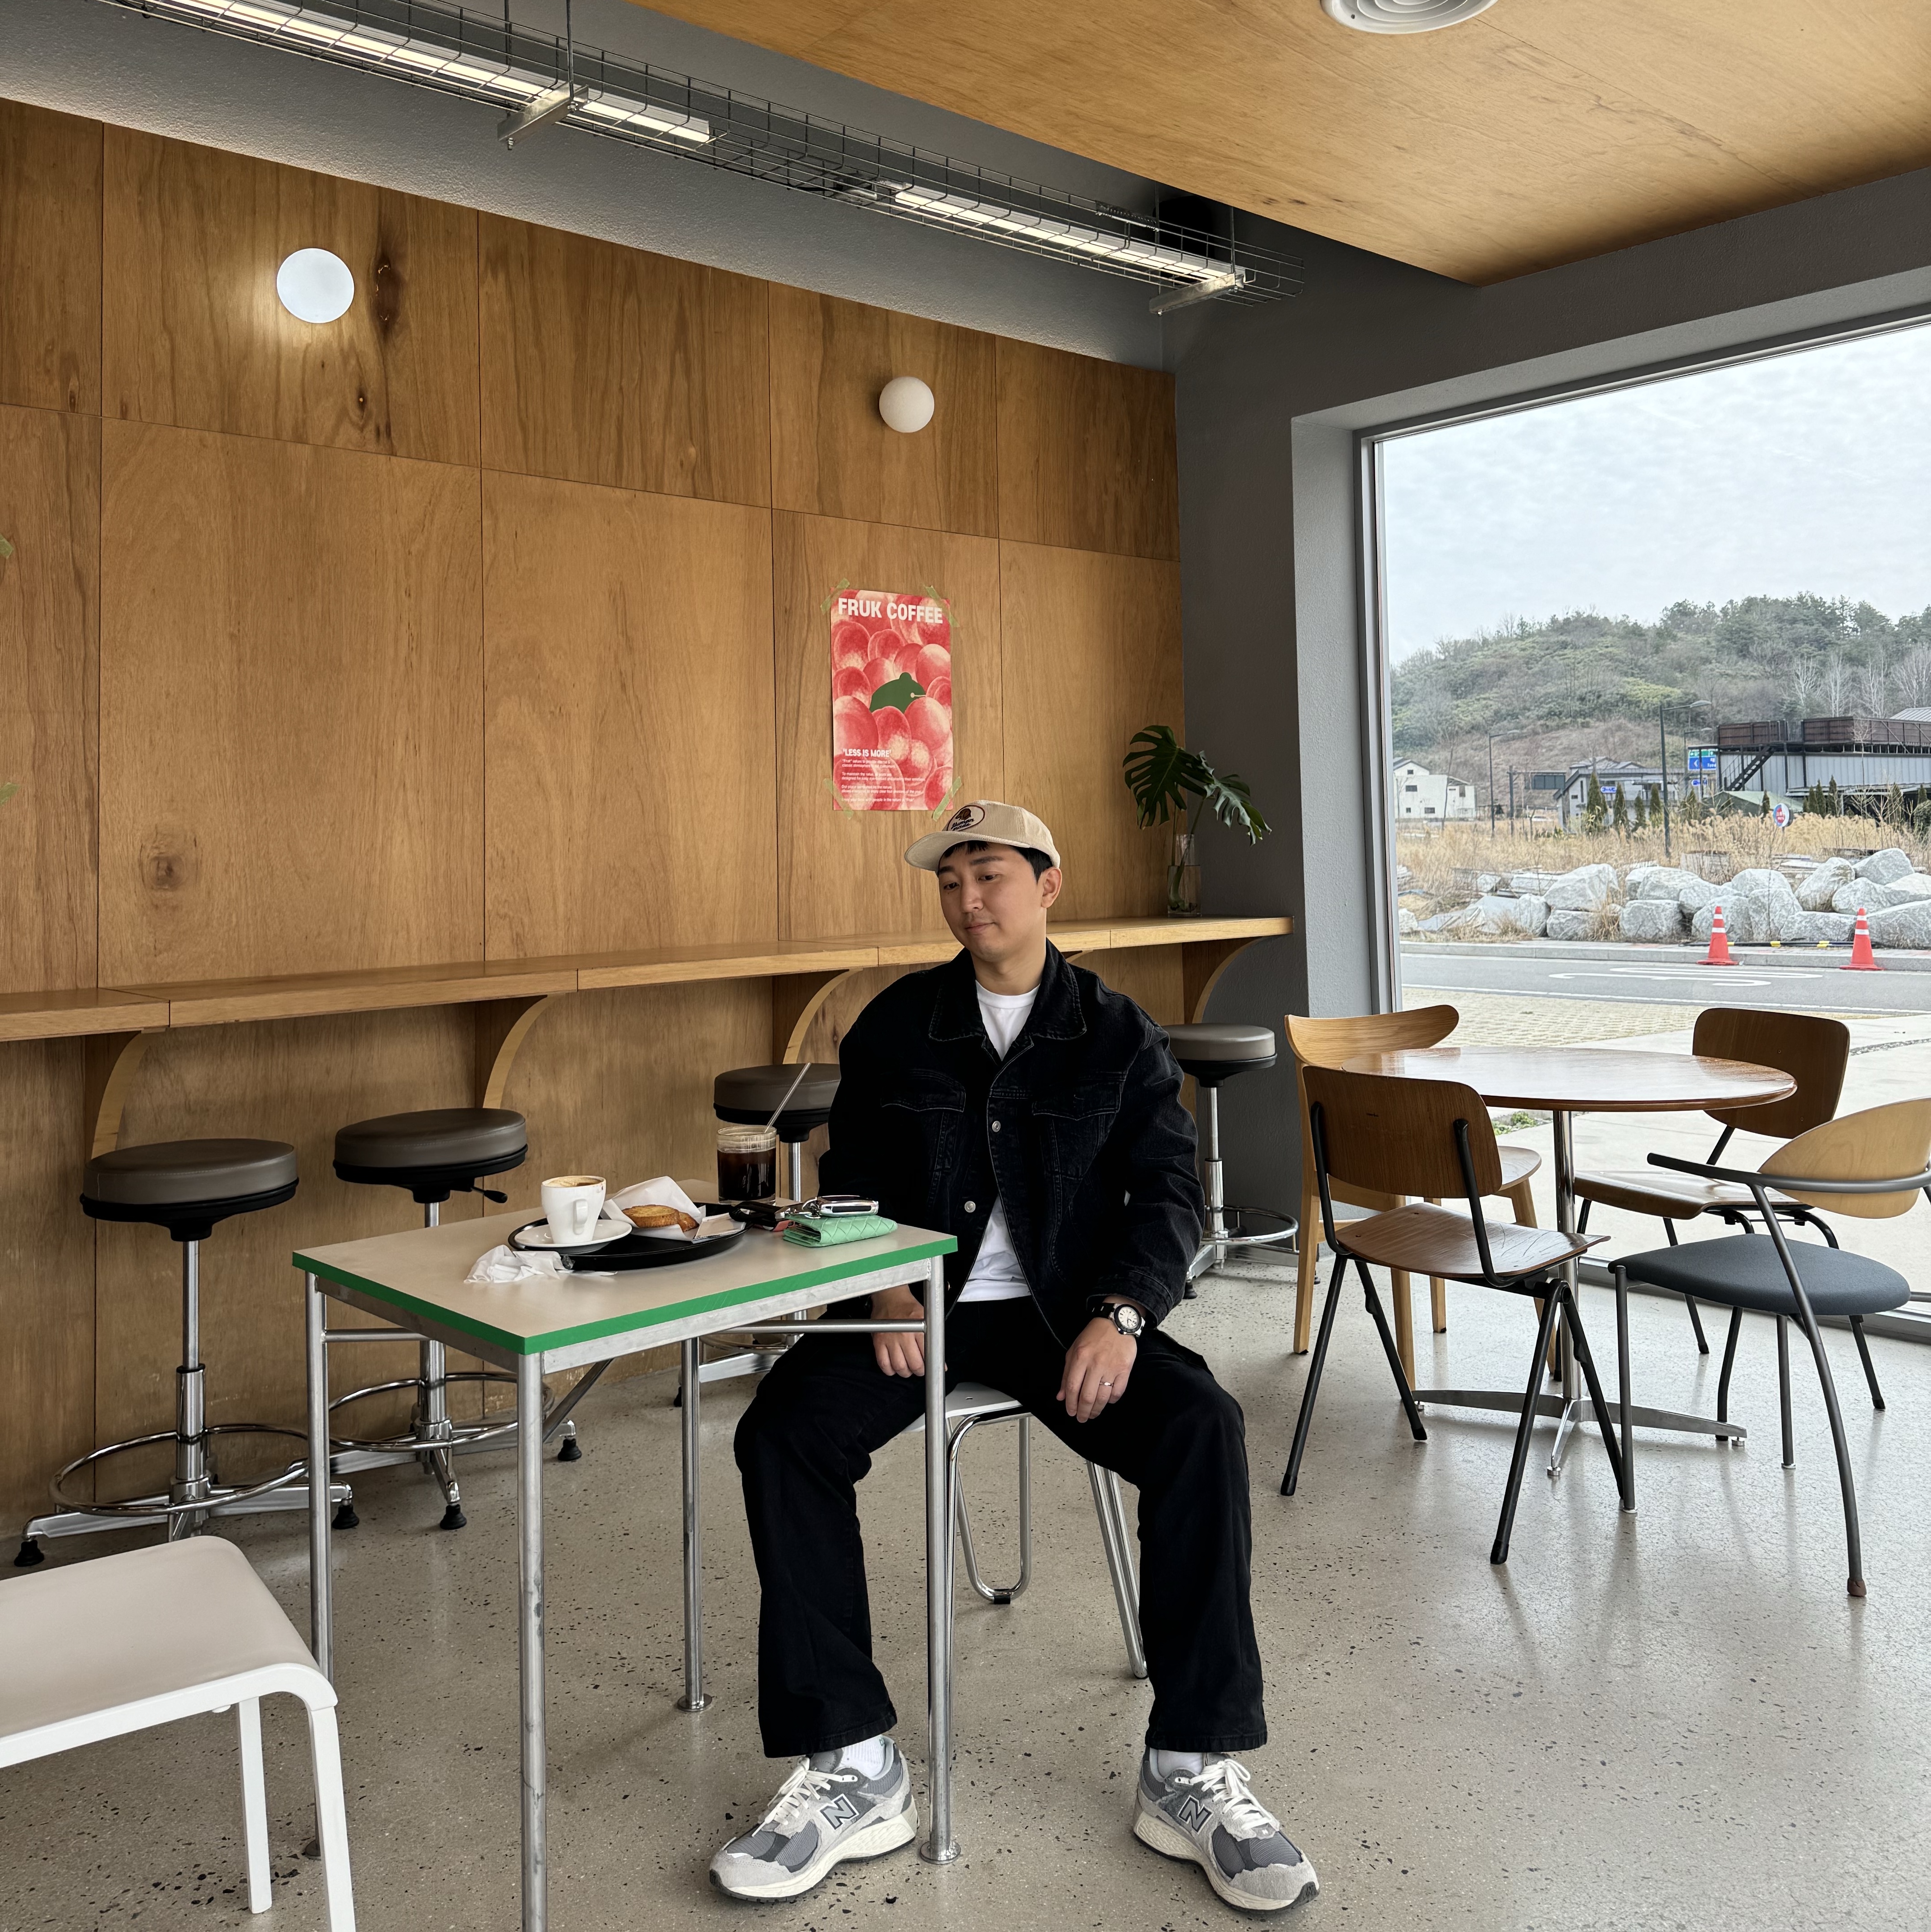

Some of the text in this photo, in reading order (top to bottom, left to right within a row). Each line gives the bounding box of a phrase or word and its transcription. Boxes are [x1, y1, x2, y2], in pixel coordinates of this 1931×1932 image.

[839, 597, 943, 624] FRUK COFFEE
[862, 749, 869, 757] IS
[817, 1793, 860, 1830] N
[1178, 1794, 1214, 1835] N
